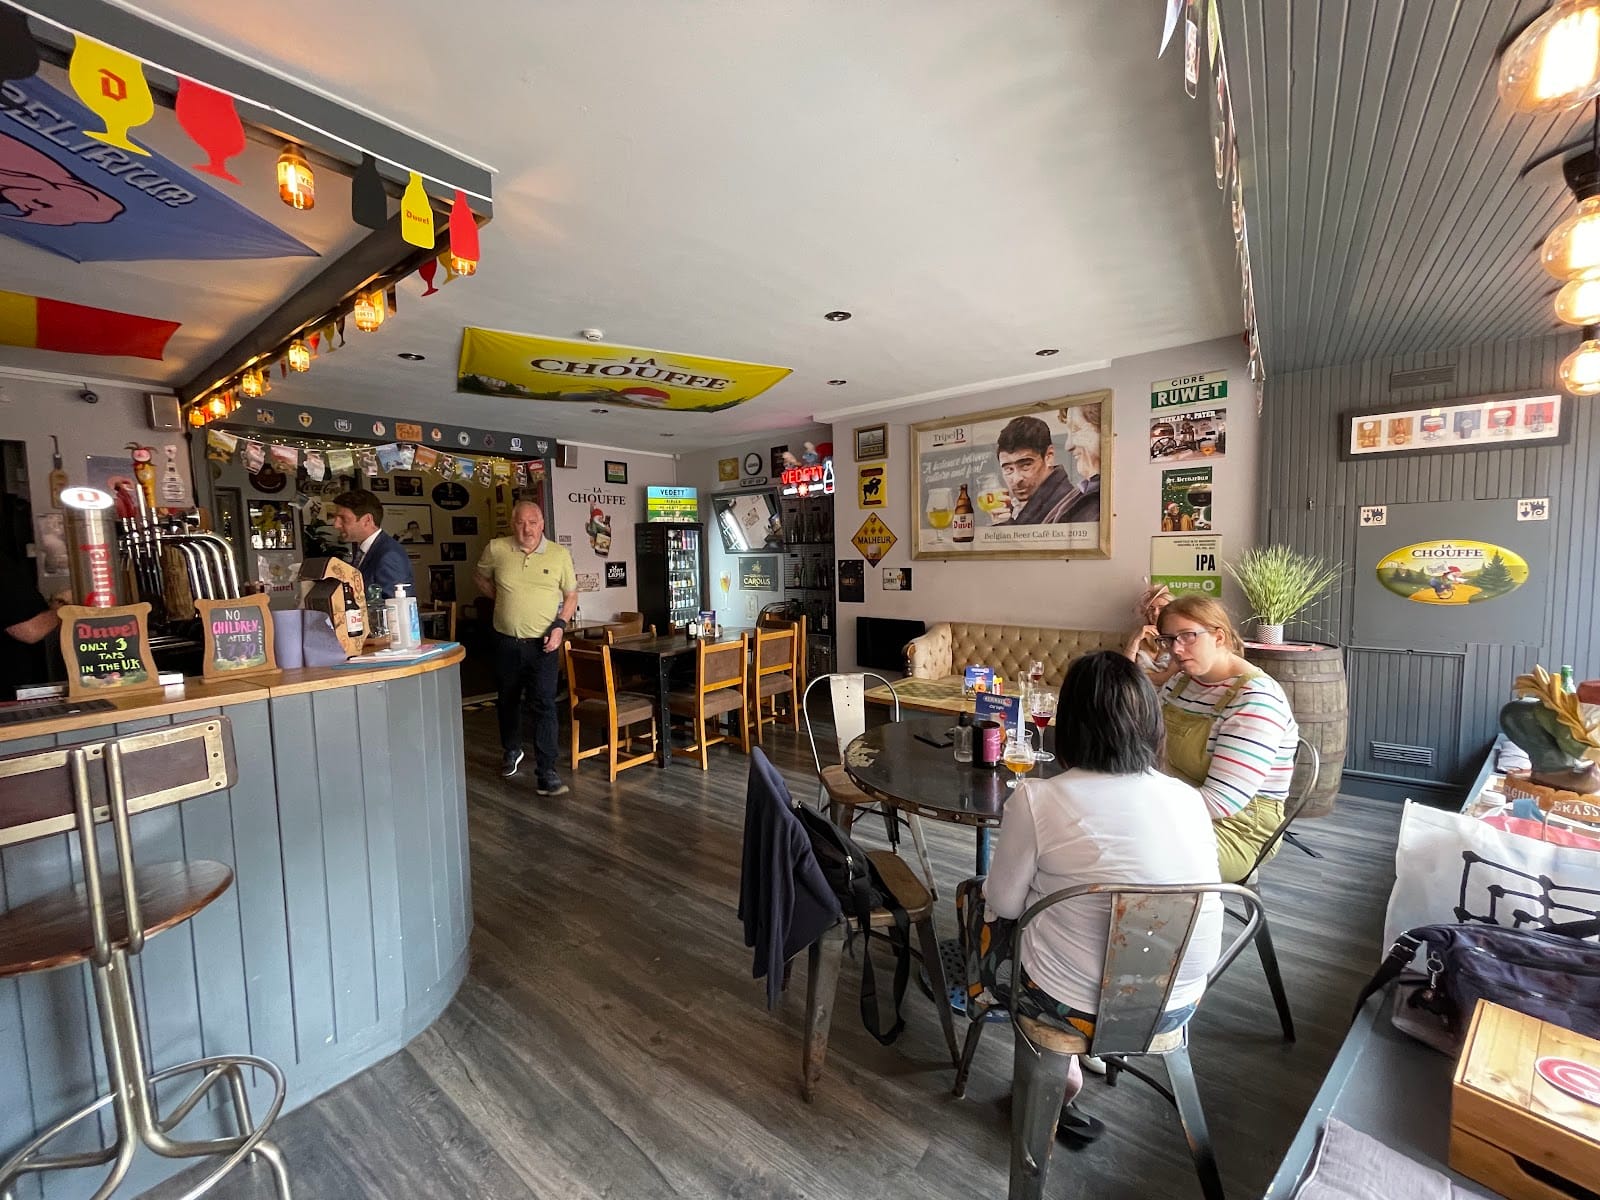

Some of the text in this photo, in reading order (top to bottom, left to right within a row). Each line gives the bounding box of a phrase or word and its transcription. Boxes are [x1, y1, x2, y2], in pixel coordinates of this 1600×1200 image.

[406, 209, 430, 225] Duvel
[628, 356, 657, 367] LA
[530, 358, 731, 392] CHOUFFE
[1171, 375, 1205, 387] CIDRE
[1157, 382, 1222, 406] RUWET
[781, 465, 824, 485] VEDETT
[568, 492, 627, 506] CHOUFFE
[953, 520, 973, 529] Duvel
[857, 535, 892, 545] MALHEUR
[984, 530, 1088, 541] Belgian Beer Café Est. 2019
[1412, 549, 1484, 558] CHOUFFE
[1196, 554, 1216, 571] IPA
[743, 577, 771, 586] CAROLUS
[1169, 581, 1201, 589] SUPER
[225, 609, 240, 621] NO
[76, 620, 138, 639] Duvel
[212, 620, 258, 635] CHILDREN
[80, 637, 128, 652] ONLY 3
[227, 634, 252, 643] AFTER
[98, 652, 125, 660] TAPS
[81, 658, 141, 673] IN THE UK
